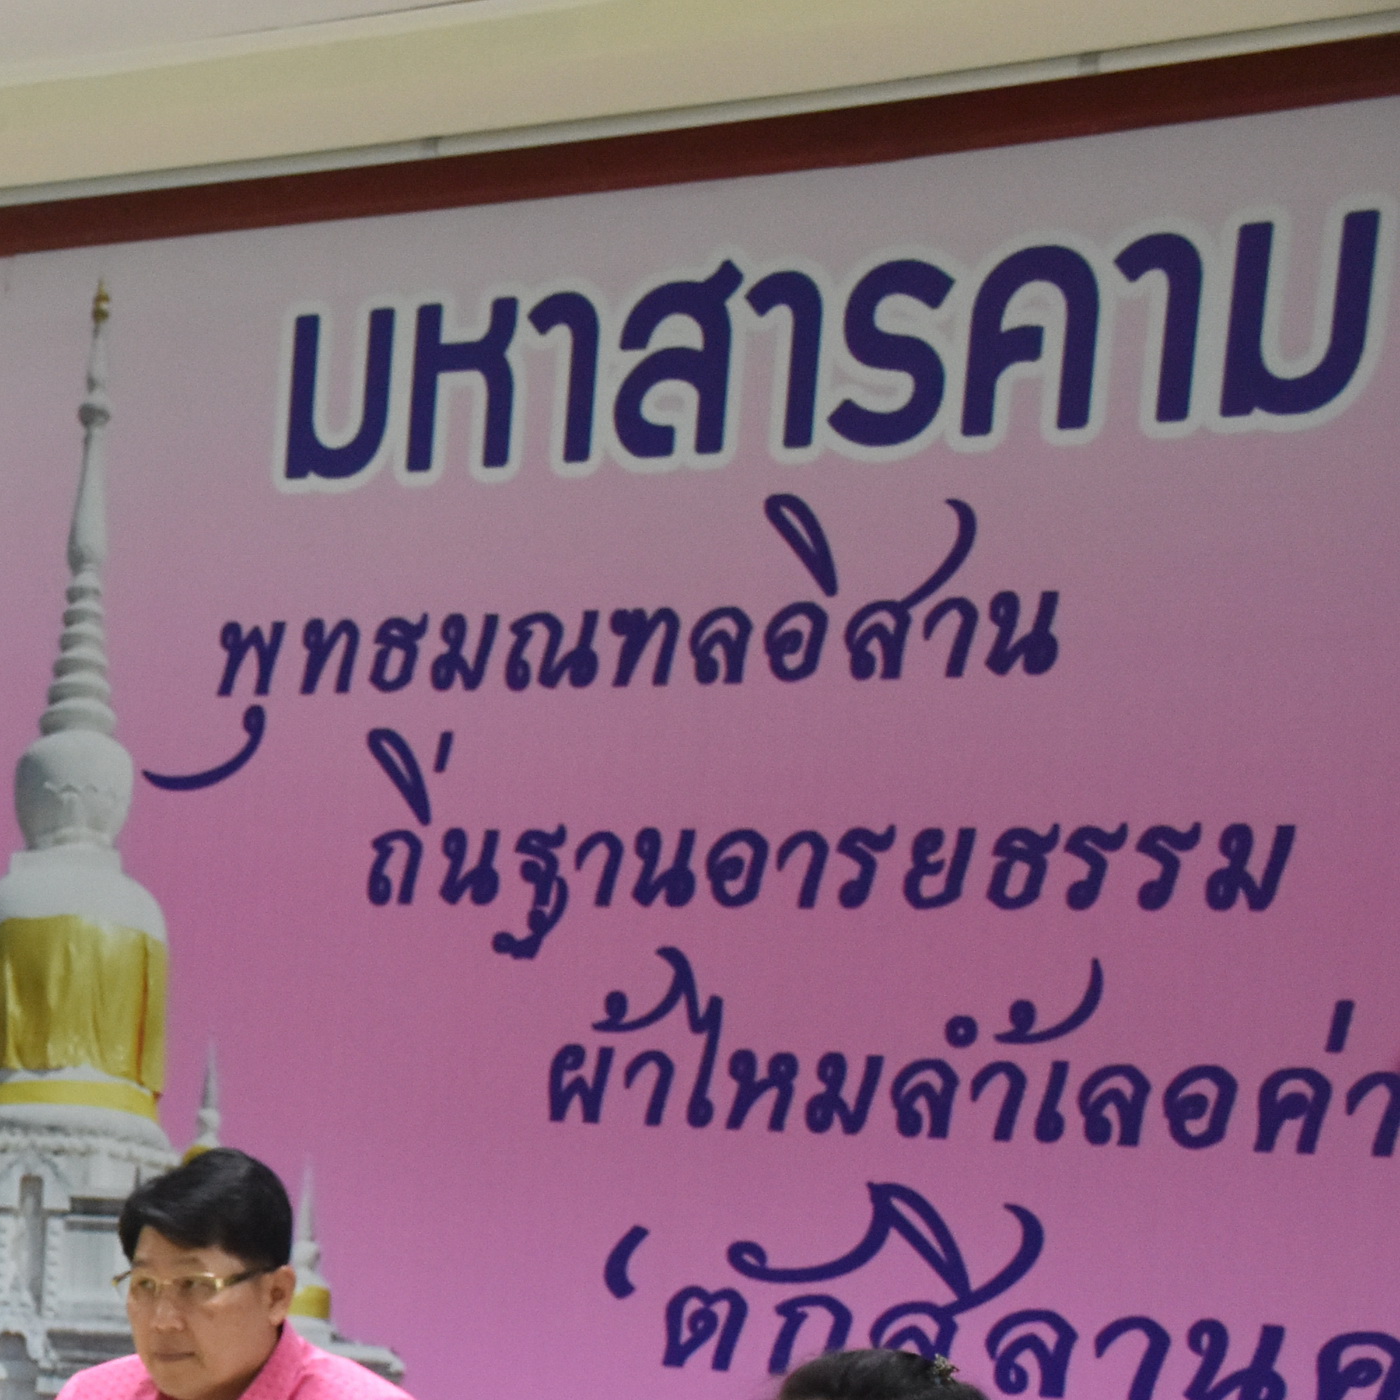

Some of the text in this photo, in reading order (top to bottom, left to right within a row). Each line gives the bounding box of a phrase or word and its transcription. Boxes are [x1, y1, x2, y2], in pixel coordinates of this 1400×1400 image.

[284, 208, 1382, 481] มหาสารคาม
[366, 727, 1298, 961] ถิ่นฐานอารยธรรม
[547, 945, 1400, 1158] ผ้าไหมล้ำเลอค่า
